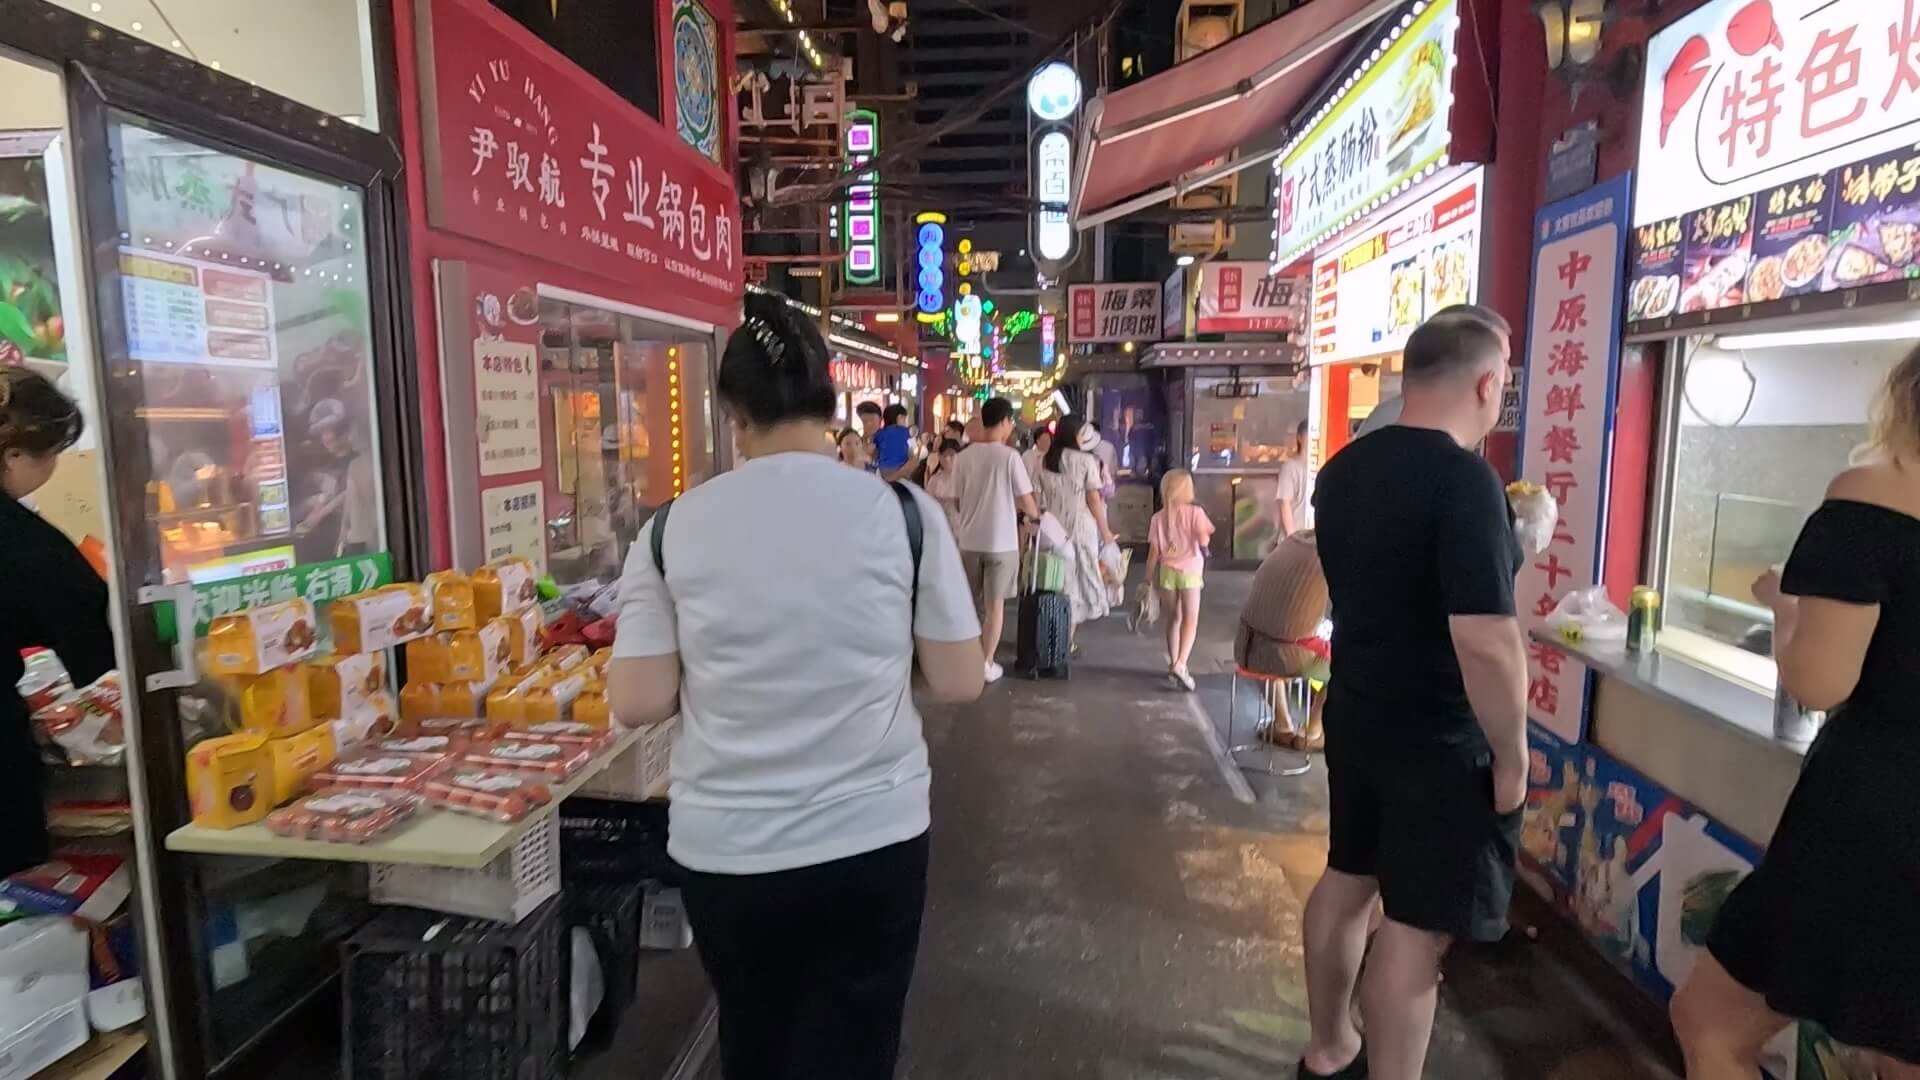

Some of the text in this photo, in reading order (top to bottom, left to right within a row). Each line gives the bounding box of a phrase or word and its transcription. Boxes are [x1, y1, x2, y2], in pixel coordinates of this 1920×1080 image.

[469, 73, 486, 103] YI
[489, 59, 509, 82] YU
[524, 77, 558, 145] HANG
[469, 127, 565, 208] 尹驭航
[580, 121, 733, 271] 专业锅包肉
[1295, 107, 1378, 222] 广式蒸肠粉
